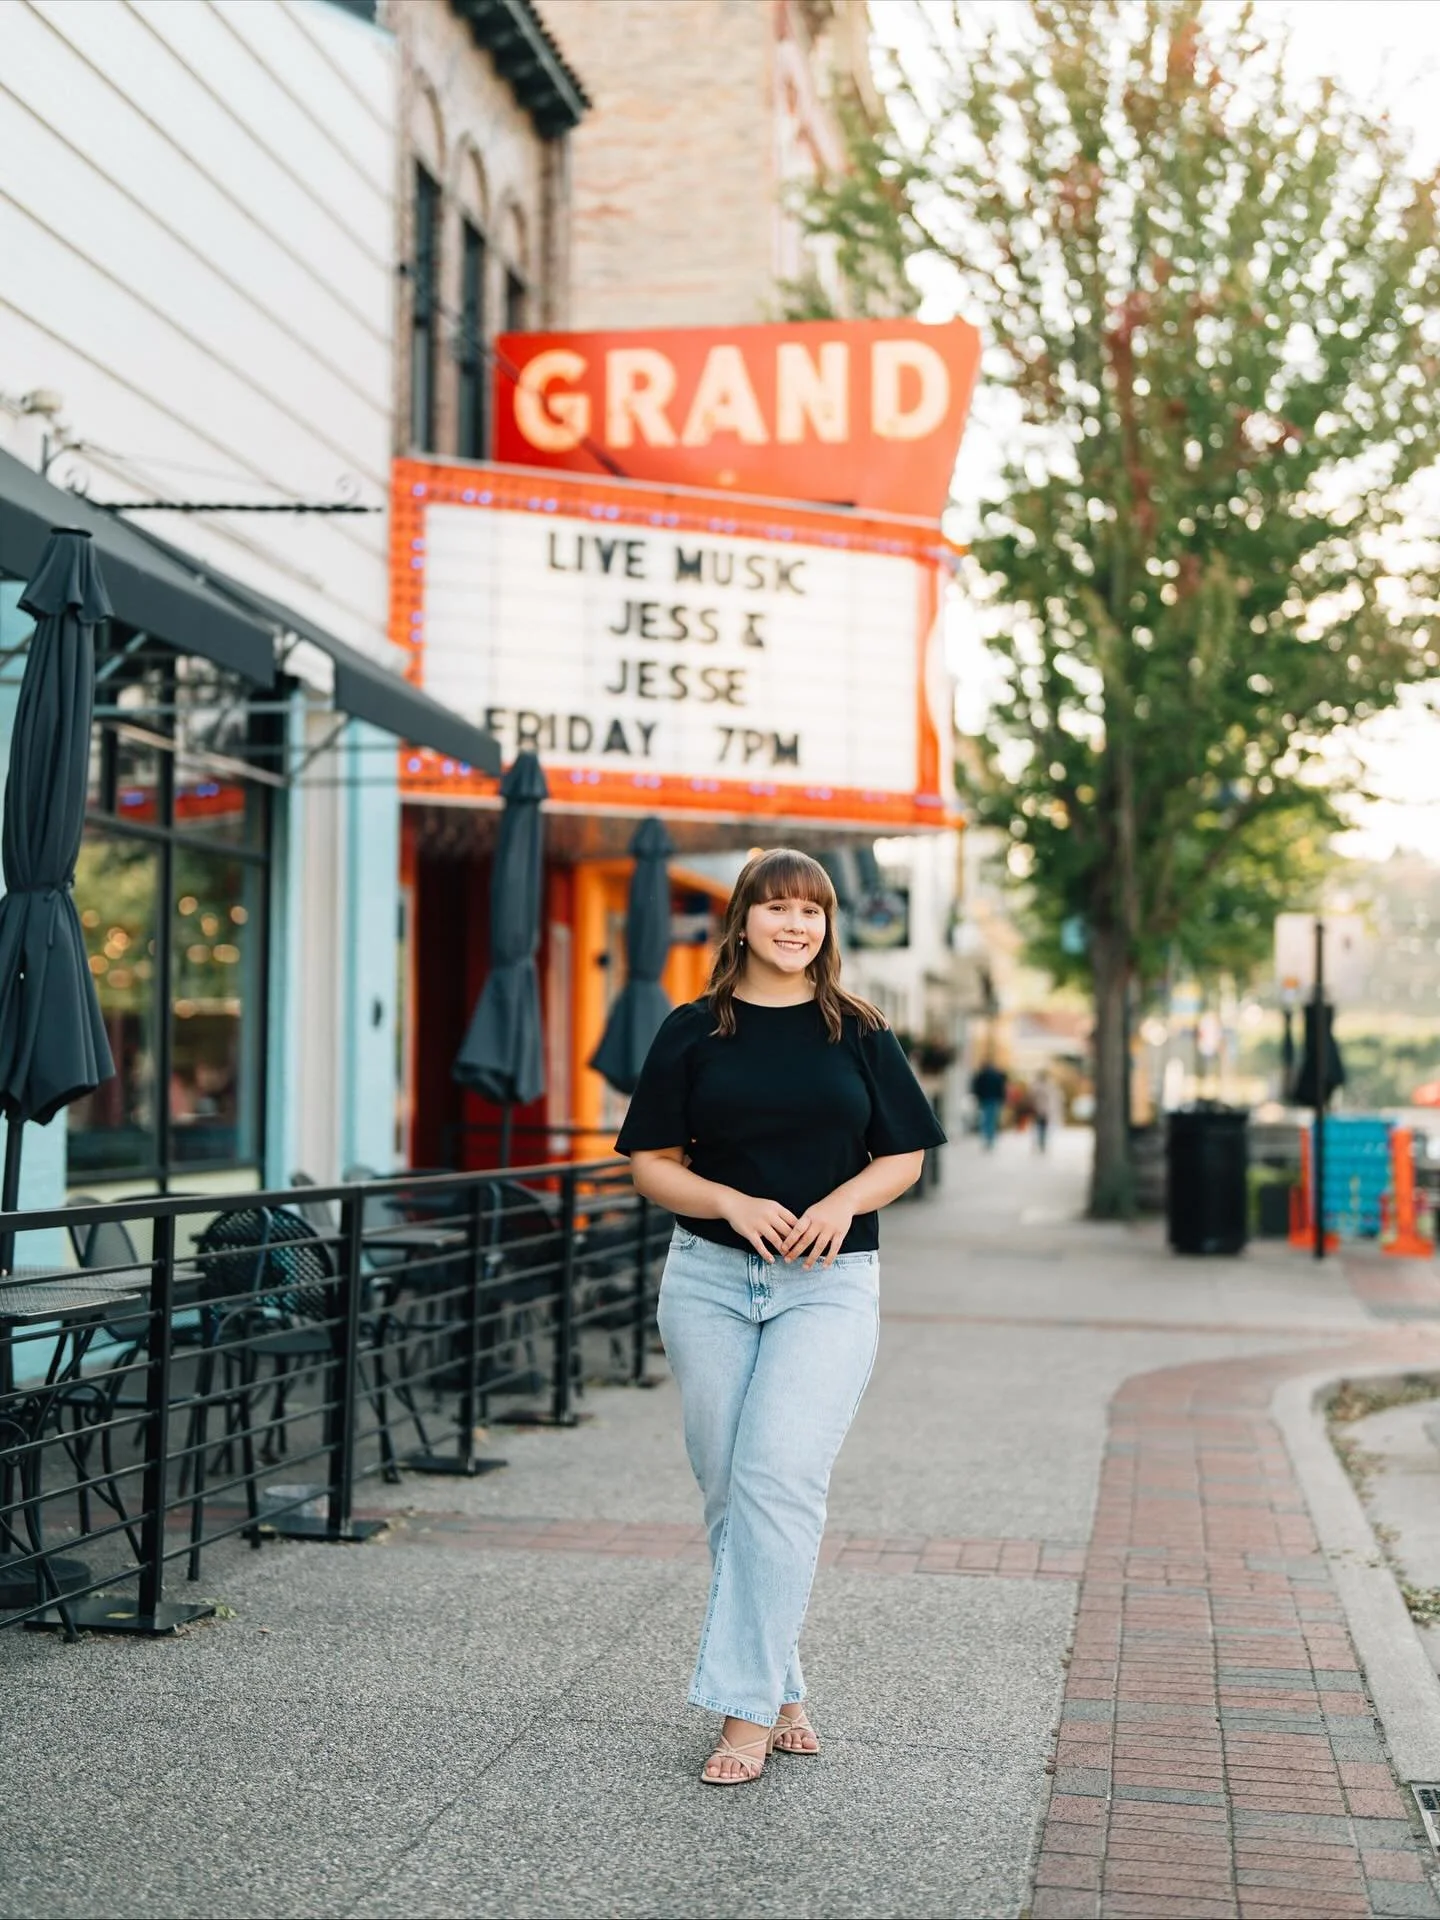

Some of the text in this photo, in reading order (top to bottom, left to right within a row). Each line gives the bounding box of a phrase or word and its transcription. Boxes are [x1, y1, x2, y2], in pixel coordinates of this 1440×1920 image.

[513, 339, 951, 454] GRAND
[549, 531, 806, 596] LIVE MUSIC
[609, 599, 766, 649] JESS &
[606, 658, 747, 707] JESSE
[484, 706, 800, 768] FRIDAY 7PM
